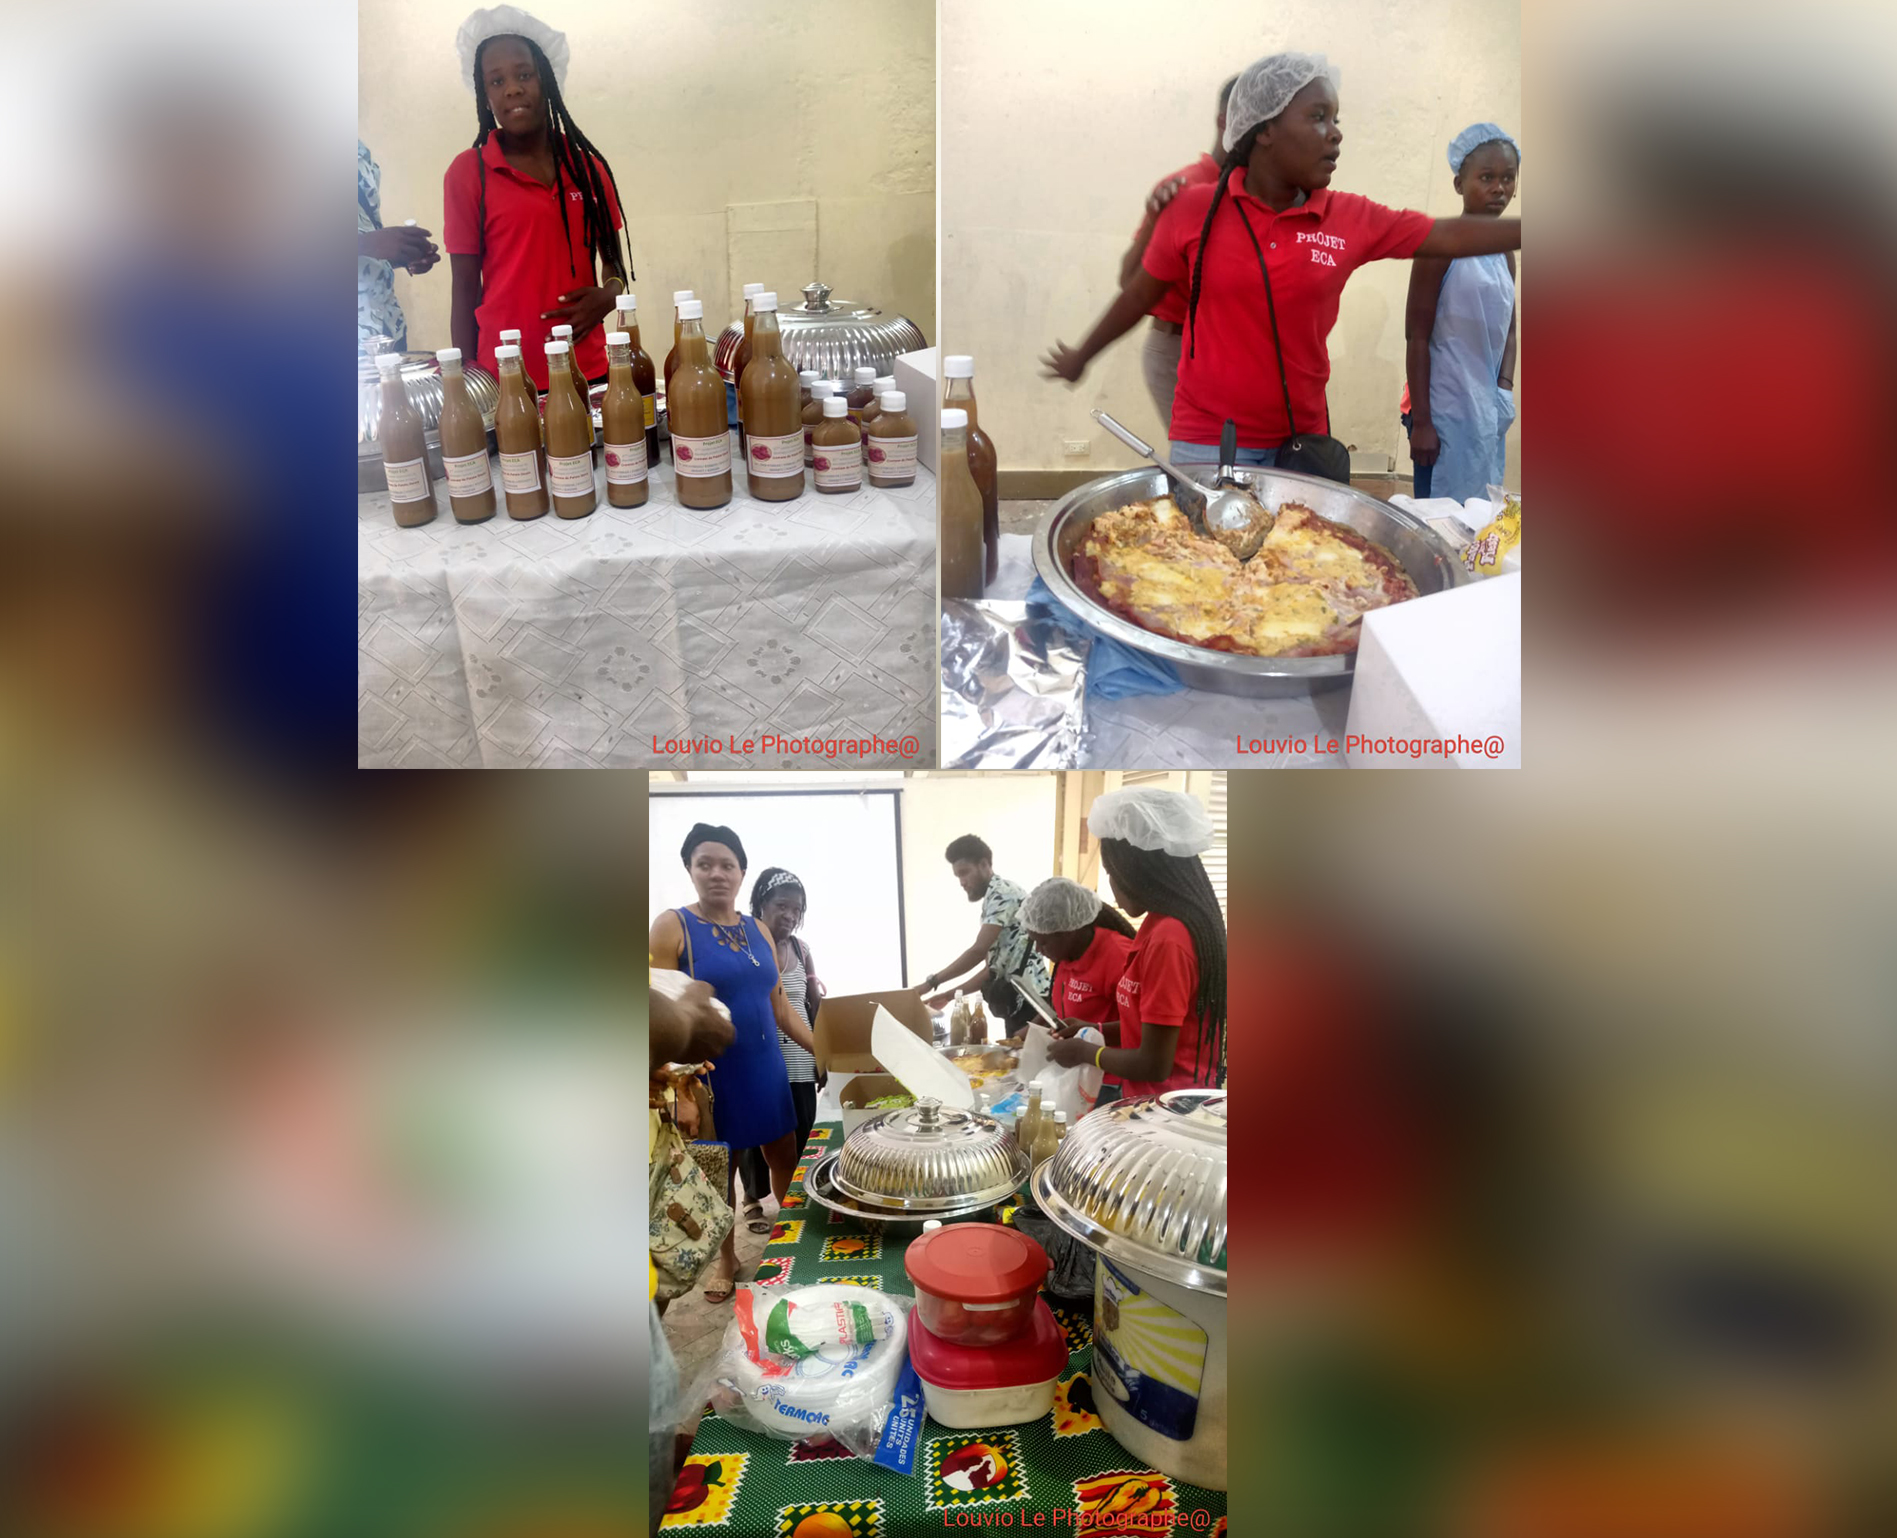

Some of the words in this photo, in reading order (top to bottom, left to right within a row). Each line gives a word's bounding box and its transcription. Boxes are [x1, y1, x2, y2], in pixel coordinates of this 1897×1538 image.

[1296, 231, 1346, 250] PROJET
[1311, 249, 1337, 267] ECA
[1068, 977, 1093, 992] ROJET
[1068, 991, 1082, 1003] ECA
[899, 1393, 920, 1418] 25
[1140, 1410, 1148, 1421] 5
[886, 1415, 900, 1449] UNITES
[895, 1418, 908, 1446] UNITS
[898, 1419, 915, 1465] UNIDADES
